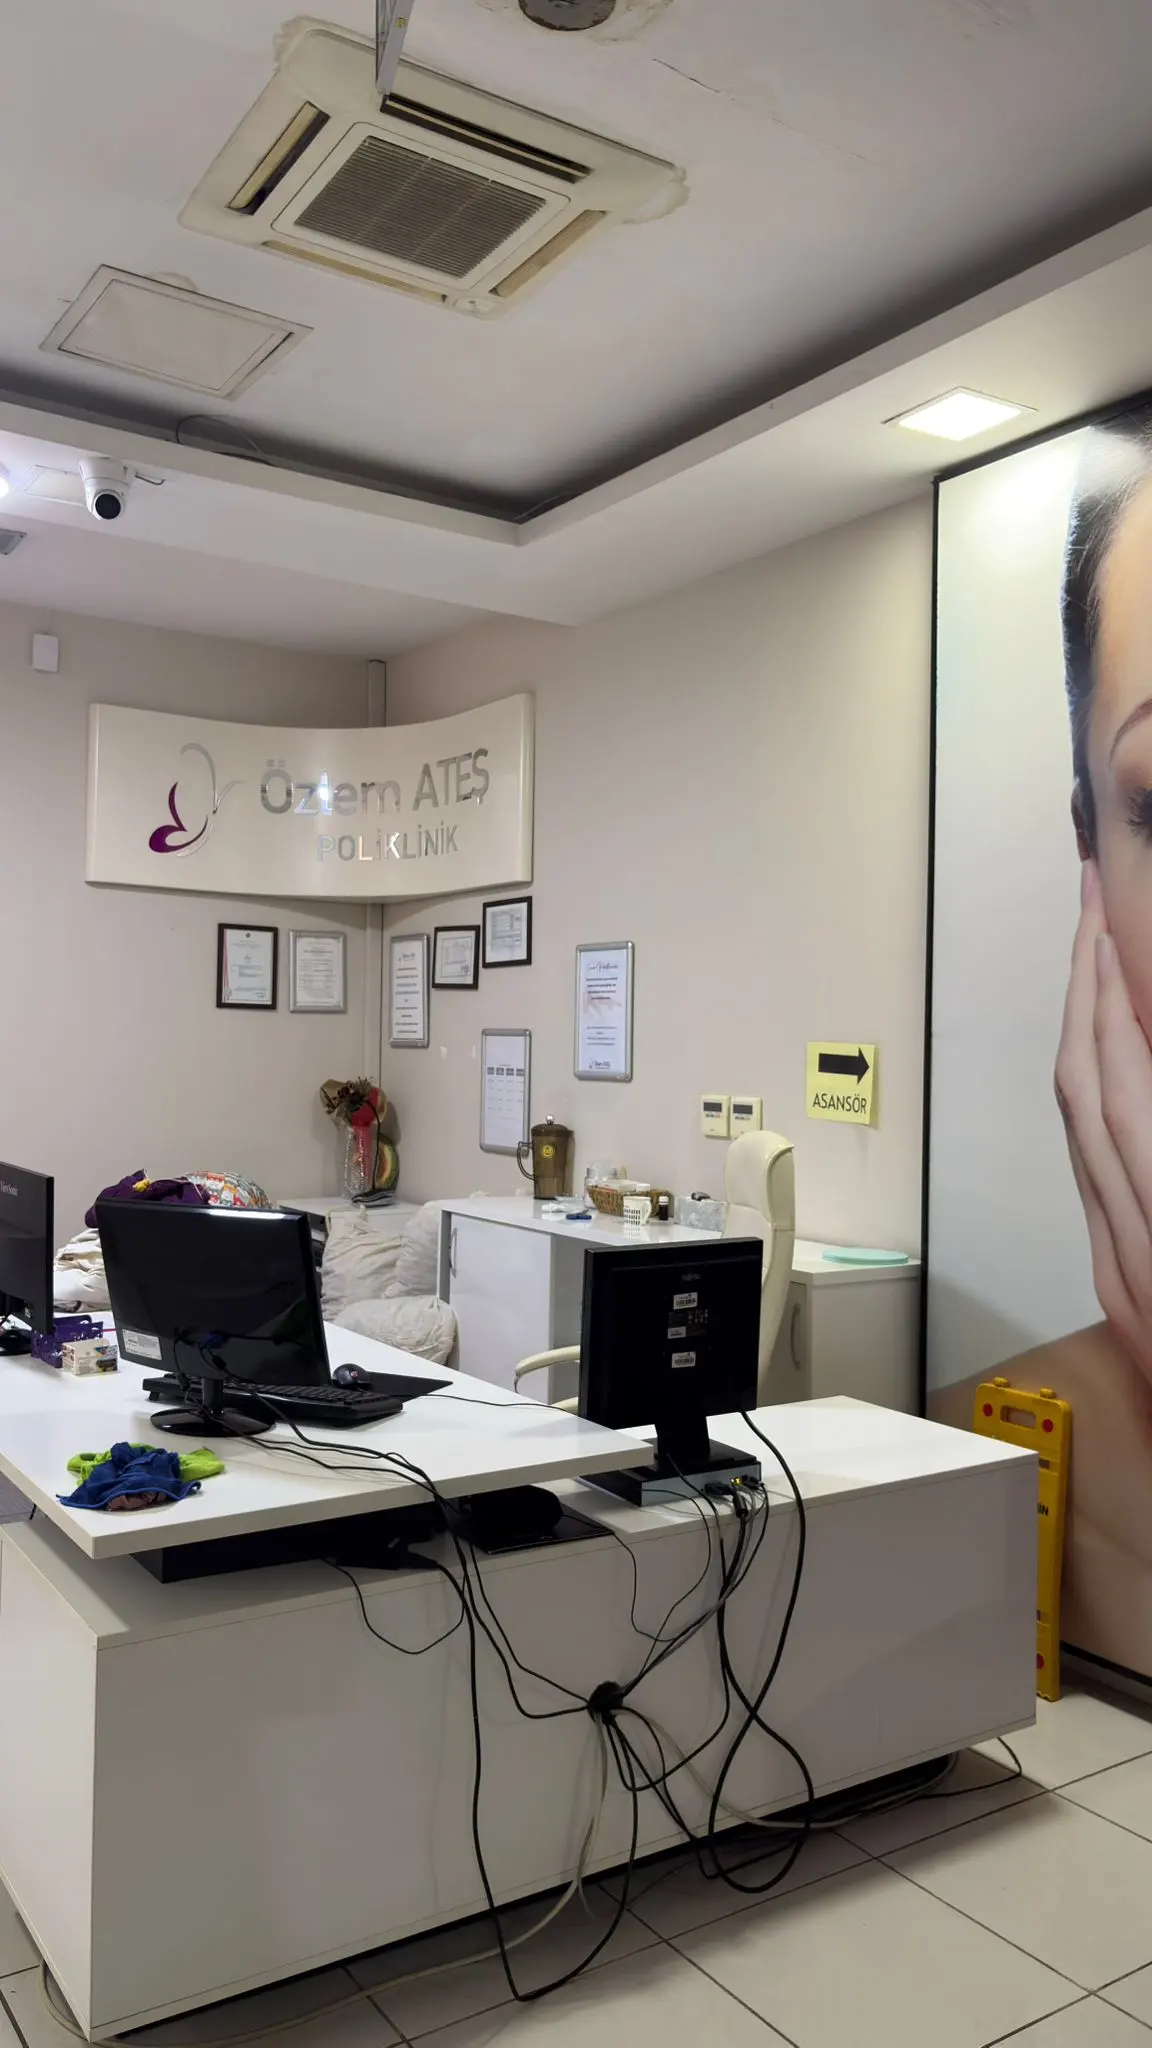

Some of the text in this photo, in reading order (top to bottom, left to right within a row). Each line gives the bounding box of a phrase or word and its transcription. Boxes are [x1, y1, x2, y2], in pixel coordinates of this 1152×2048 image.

[261, 748, 490, 816] Özlem ATEŞ
[318, 820, 458, 862] POLİKLİNİK
[813, 1093, 867, 1114] ASANSÖR
